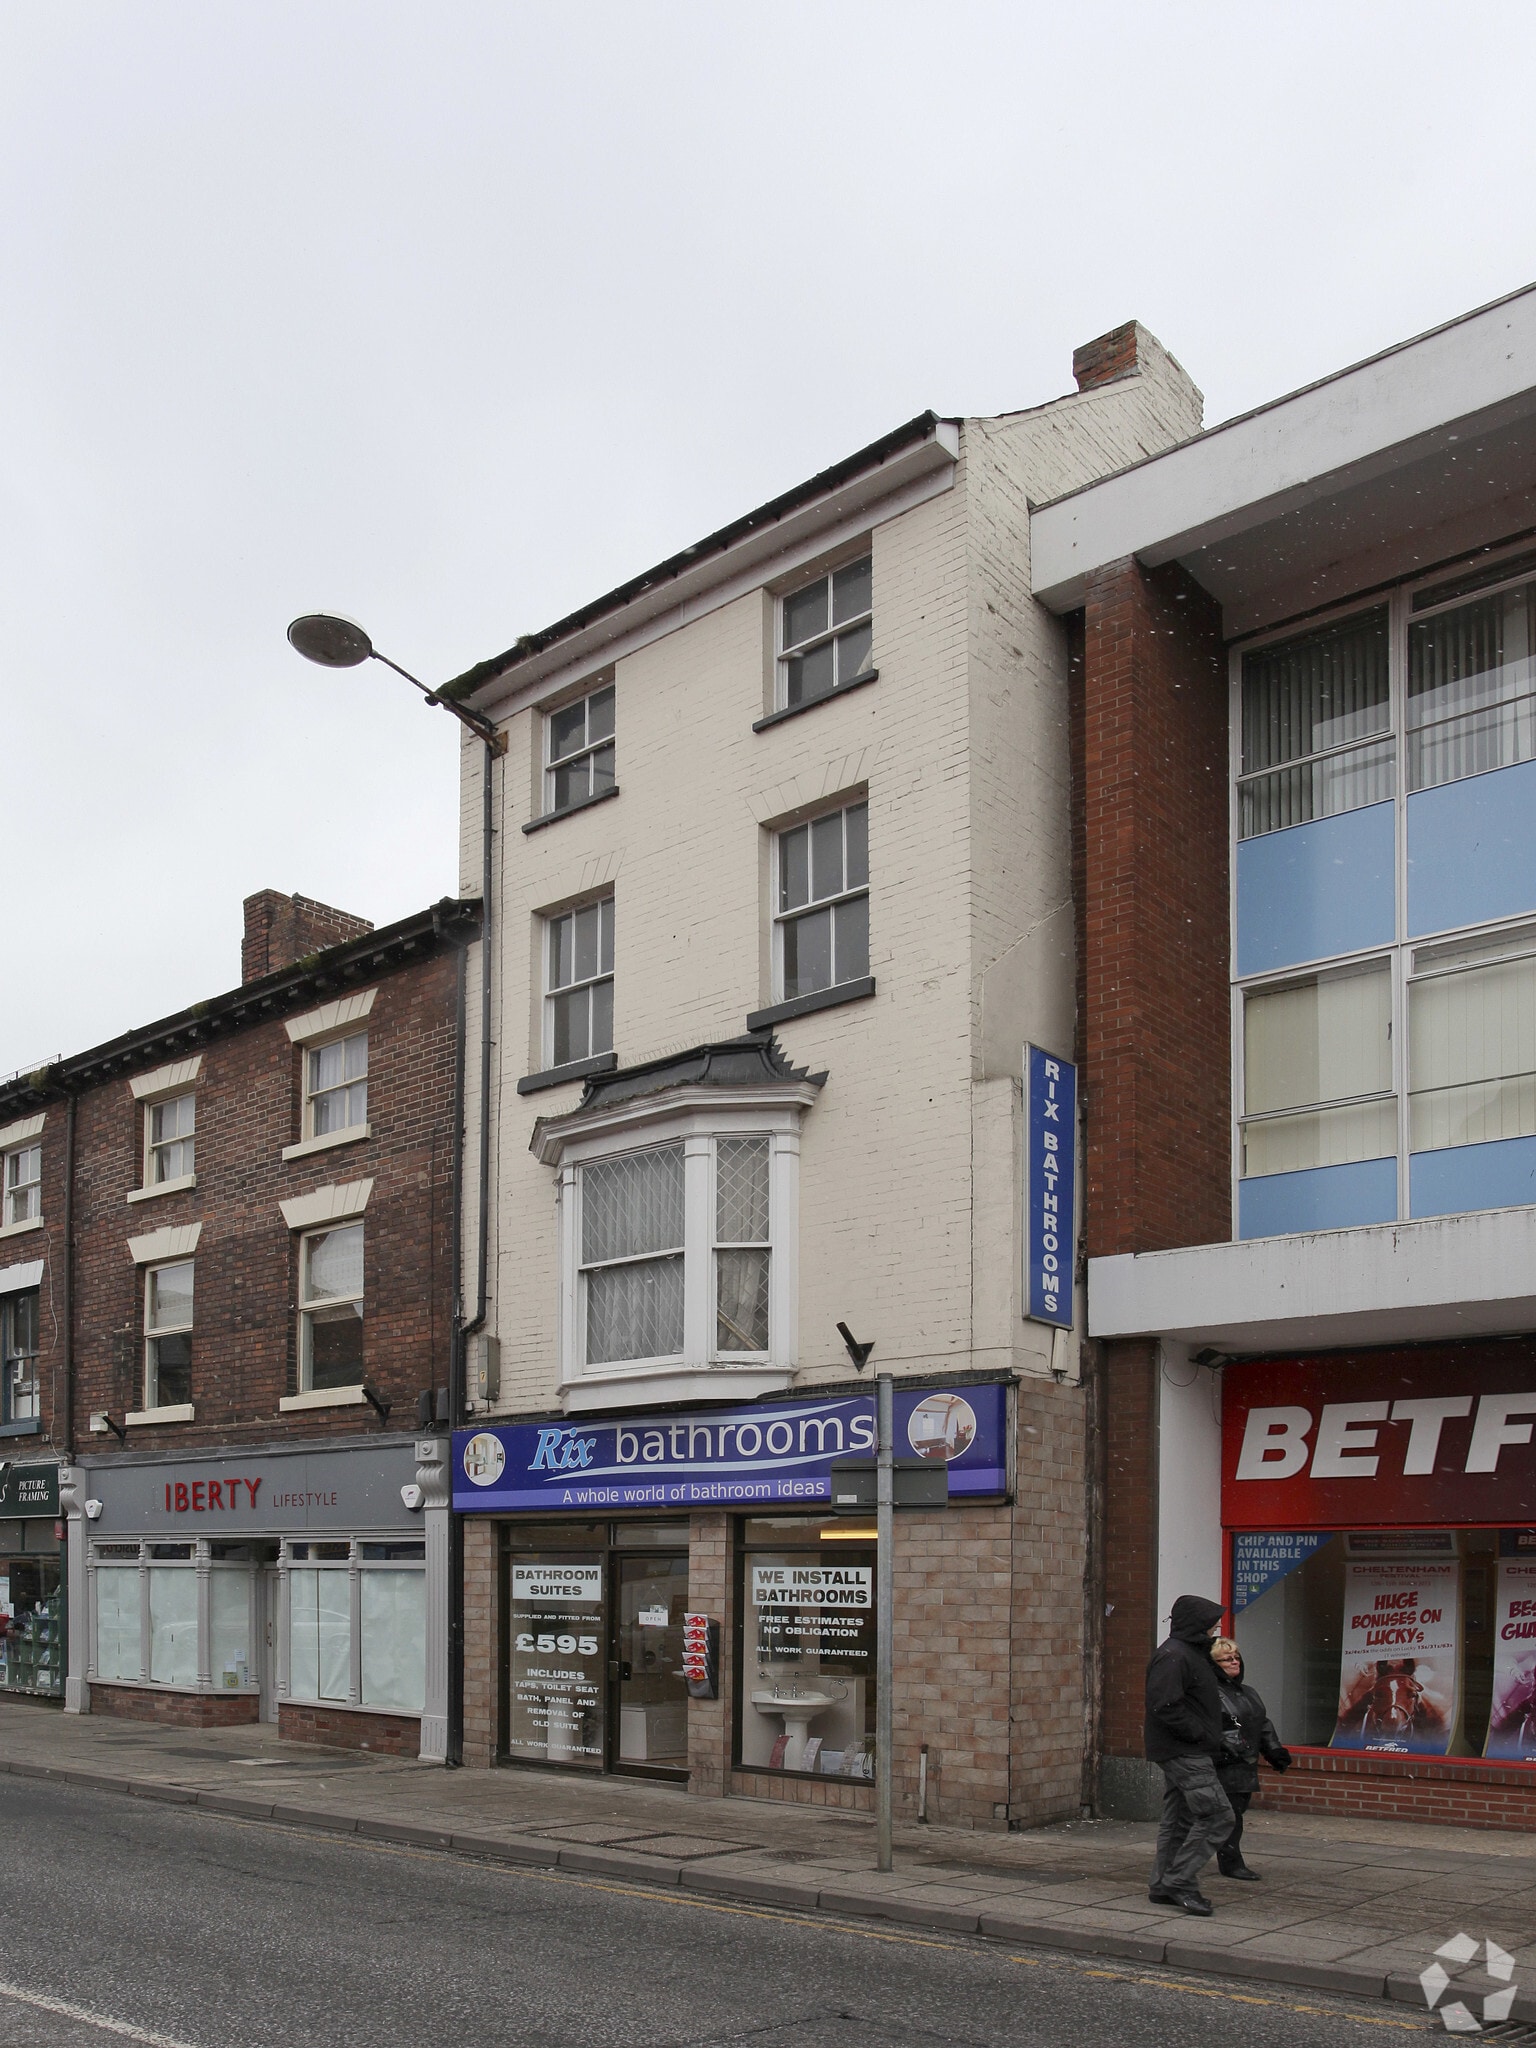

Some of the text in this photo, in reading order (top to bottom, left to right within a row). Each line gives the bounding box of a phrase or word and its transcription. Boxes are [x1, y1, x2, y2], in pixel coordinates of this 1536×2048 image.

[1042, 1058, 1060, 1313] RIX BATHROOMS
[1235, 1392, 1536, 1480] BETF
[527, 1415, 874, 1471] Rix bathrooms
[18, 1479, 46, 1491] PICTURE
[18, 1491, 50, 1502] FRAMING
[165, 1477, 338, 1512] IBERTY LIFESTYLE
[563, 1479, 825, 1504] A whole world of bathroom ideas
[1237, 1535, 1318, 1546] CHIP AND PIN
[1237, 1548, 1301, 1558] AVAILABLE
[1237, 1560, 1280, 1571] IN THIS
[515, 1570, 598, 1580] BATHROOM
[758, 1571, 866, 1585] WE INSTALL
[1236, 1572, 1268, 1583] SHOP
[530, 1585, 582, 1595] SUITES
[756, 1588, 868, 1604] BATHROOMS
[1374, 1591, 1418, 1610] HUGE
[759, 1615, 864, 1626] FREE ESTIMATES
[1351, 1609, 1442, 1629] BONUSES ON
[763, 1626, 858, 1637] NO OBLIGATION
[515, 1633, 599, 1656] £595
[775, 1646, 802, 1654] WORK
[806, 1648, 868, 1657] GUARANTEED
[527, 1668, 585, 1680] INCLUDES
[514, 1681, 599, 1694] TAPS, TOILET SEAT
[517, 1694, 541, 1702] BATH,
[545, 1696, 573, 1705] PANEL
[527, 1707, 569, 1717] REMOVAL
[553, 1722, 579, 1730] SUITE
[527, 1740, 549, 1748] WORK
[551, 1743, 602, 1754] GUARANTEED
[1365, 1745, 1409, 1753] BETFRED
